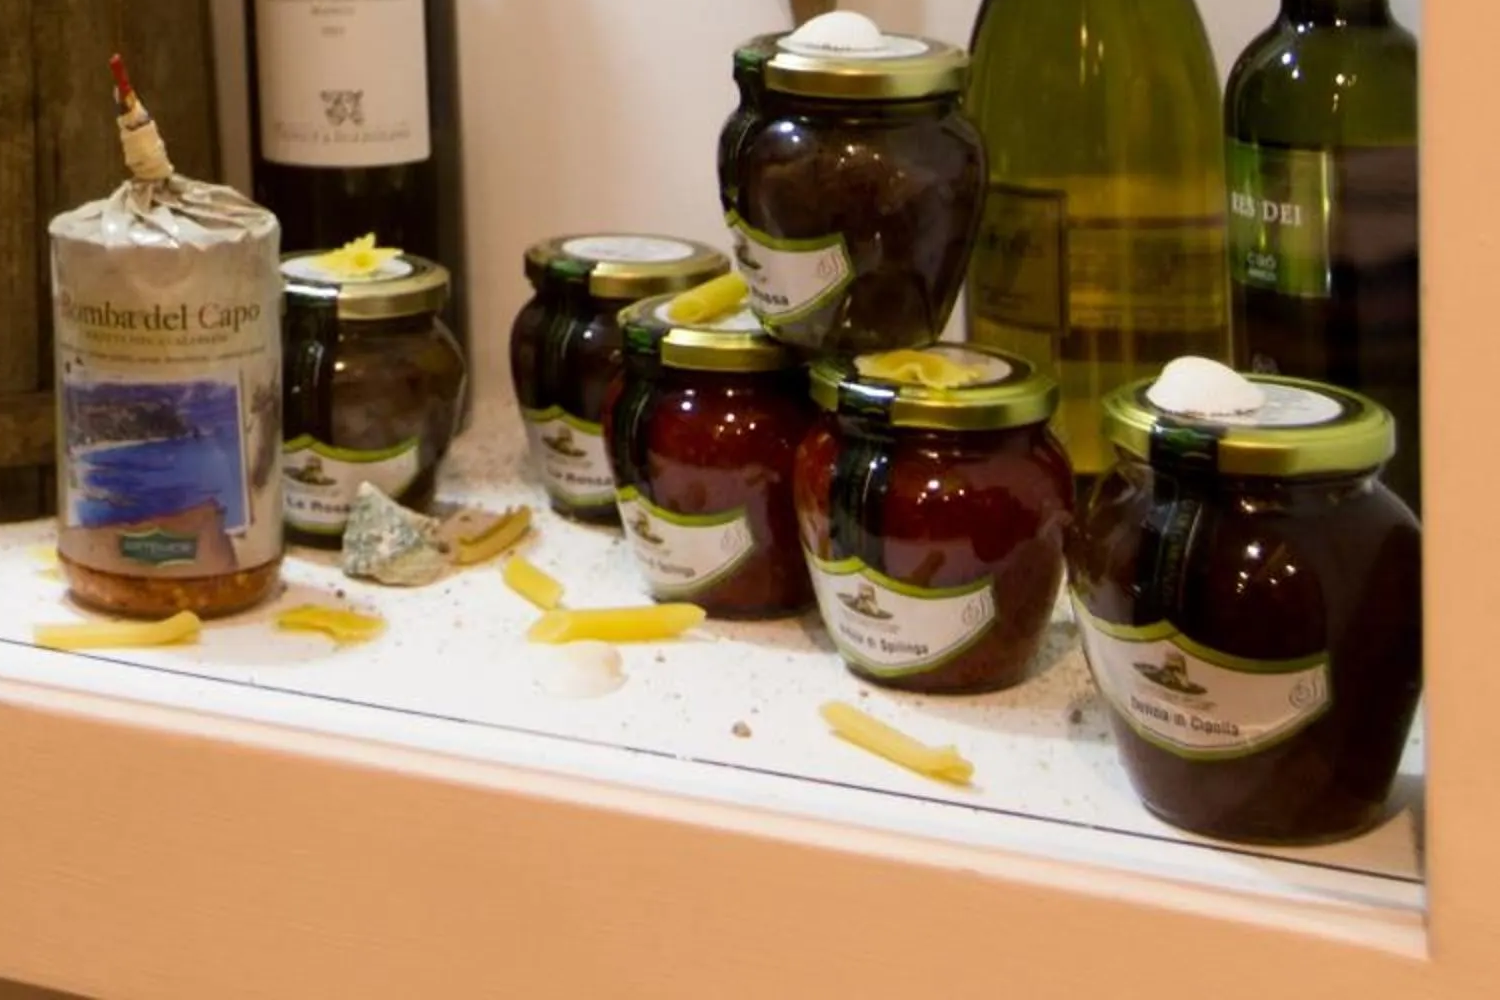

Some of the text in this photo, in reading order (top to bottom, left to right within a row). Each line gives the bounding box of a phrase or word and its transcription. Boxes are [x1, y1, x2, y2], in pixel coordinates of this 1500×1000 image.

[1262, 200, 1302, 227] DEI
[143, 303, 187, 332] del
[198, 301, 261, 332] Capo
[1190, 715, 1240, 737] Cipolla
